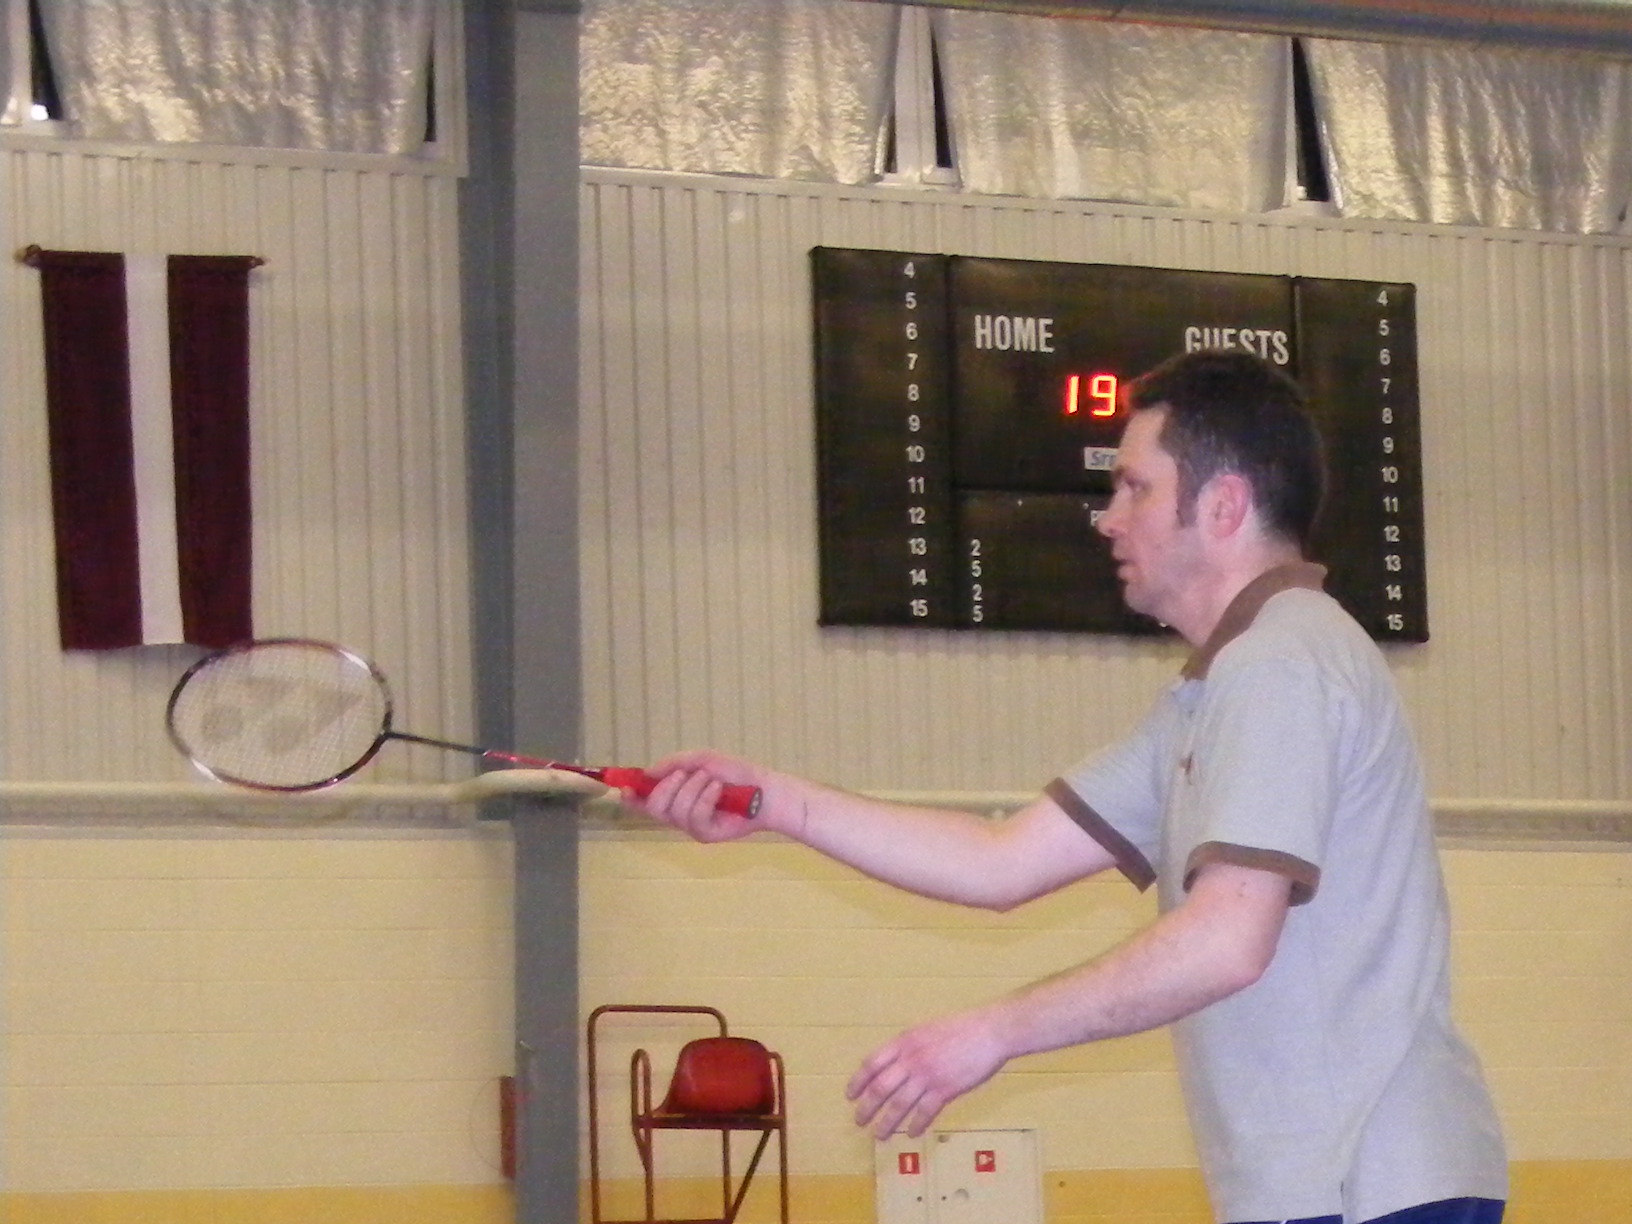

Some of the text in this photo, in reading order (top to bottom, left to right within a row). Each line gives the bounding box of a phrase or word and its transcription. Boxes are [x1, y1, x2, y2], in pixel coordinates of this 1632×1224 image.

[904, 261, 916, 278] 4
[905, 292, 917, 309] 5
[1377, 291, 1388, 306] 4
[906, 323, 918, 340] 6
[974, 314, 1055, 353] HOME
[1378, 320, 1390, 336] 5
[907, 353, 919, 370] 7
[1379, 349, 1391, 365] 6
[907, 384, 920, 401] 8
[1380, 379, 1391, 394] 7
[1065, 373, 1118, 417] 19
[908, 415, 920, 432] 9
[1382, 407, 1393, 424] 8
[1382, 437, 1394, 453] 9
[907, 446, 925, 462] 10
[1381, 467, 1398, 483] 10
[908, 477, 925, 493] 11
[1383, 497, 1398, 512] 11
[908, 507, 926, 524] 12
[1384, 526, 1400, 542] 12
[909, 538, 927, 555] 13
[1384, 555, 1401, 571] 13
[909, 569, 928, 586] 14
[1385, 585, 1402, 600] 14
[910, 600, 928, 617] 15
[1386, 614, 1403, 630] 15
